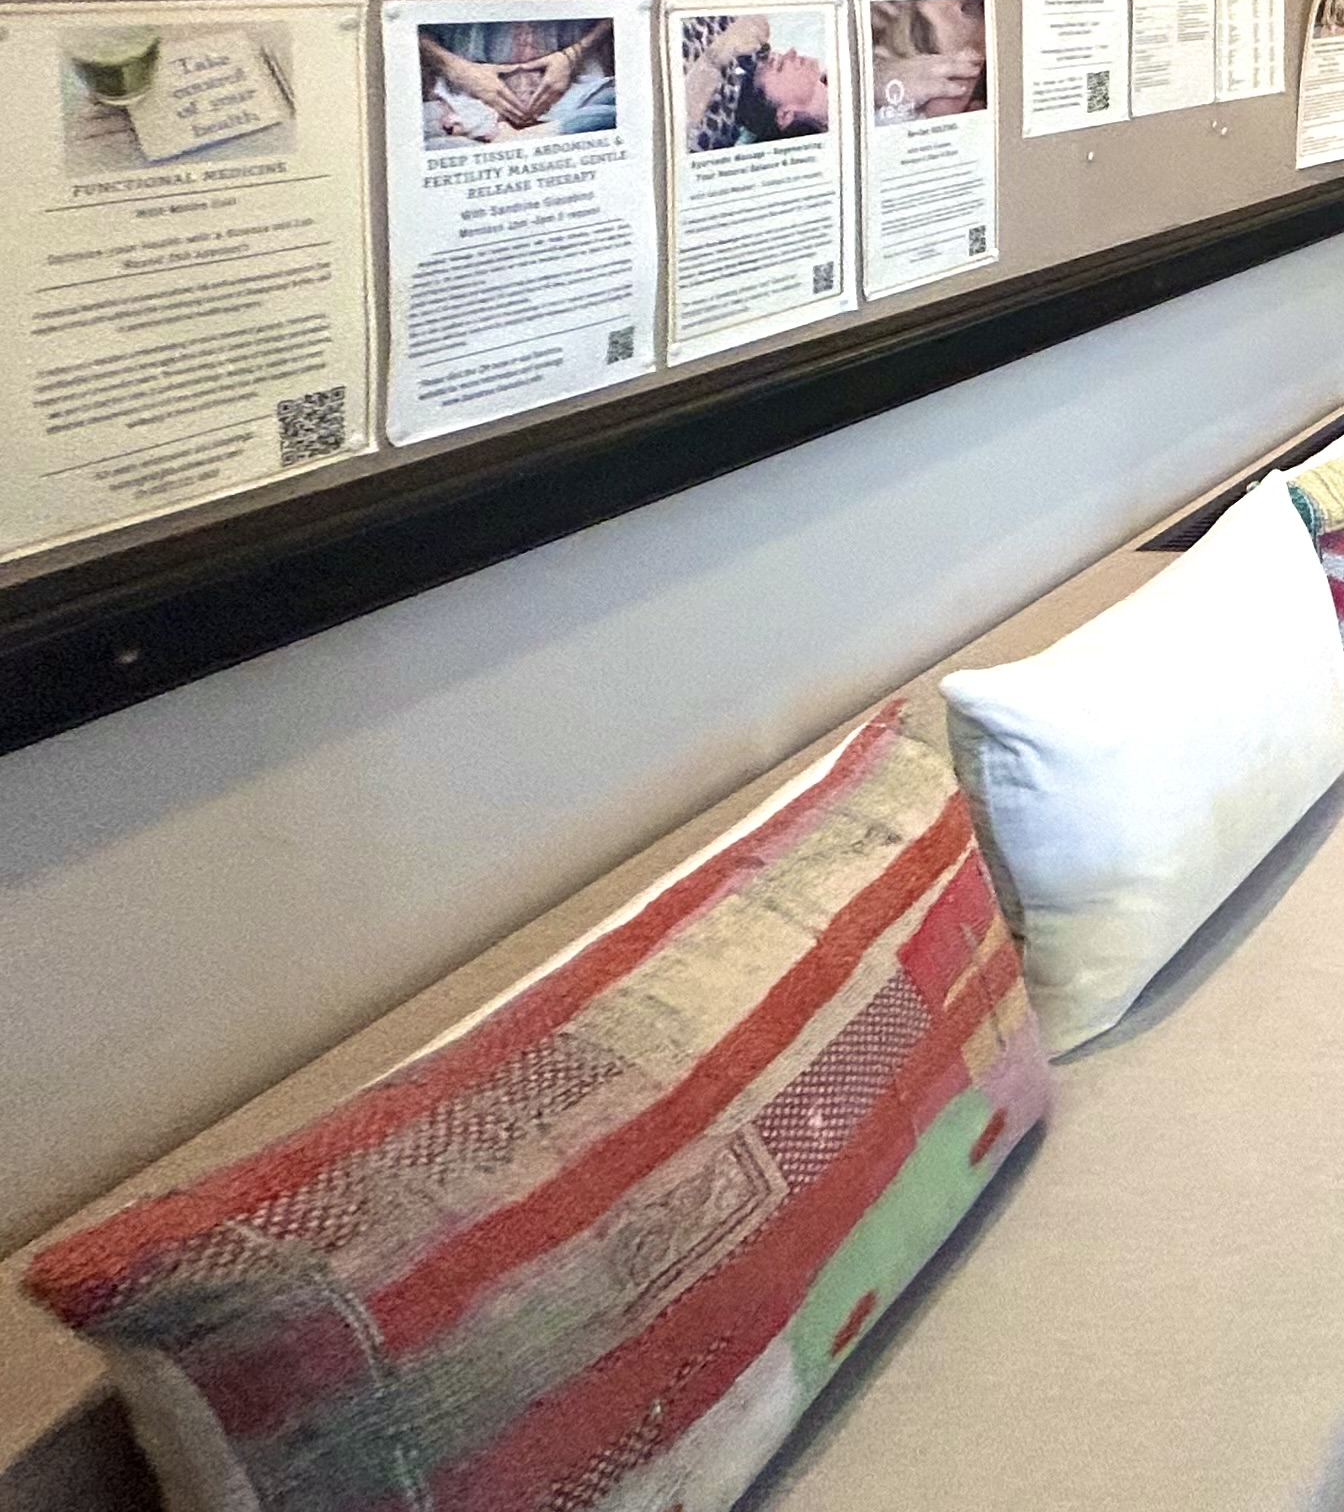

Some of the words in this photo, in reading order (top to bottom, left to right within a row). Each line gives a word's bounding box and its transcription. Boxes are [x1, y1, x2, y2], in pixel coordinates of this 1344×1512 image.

[167, 54, 231, 75] Take
[176, 99, 198, 119] of
[207, 89, 257, 113] your
[423, 167, 502, 189] FERTILITY
[579, 149, 629, 166] GENTLE
[427, 155, 469, 171] DEEP
[533, 137, 611, 157] ABDOMINAL
[72, 172, 197, 198] FUNCTIONAL
[202, 161, 288, 183] MEDICINE
[467, 179, 534, 200] RELEASE
[536, 170, 597, 189] THERAPY
